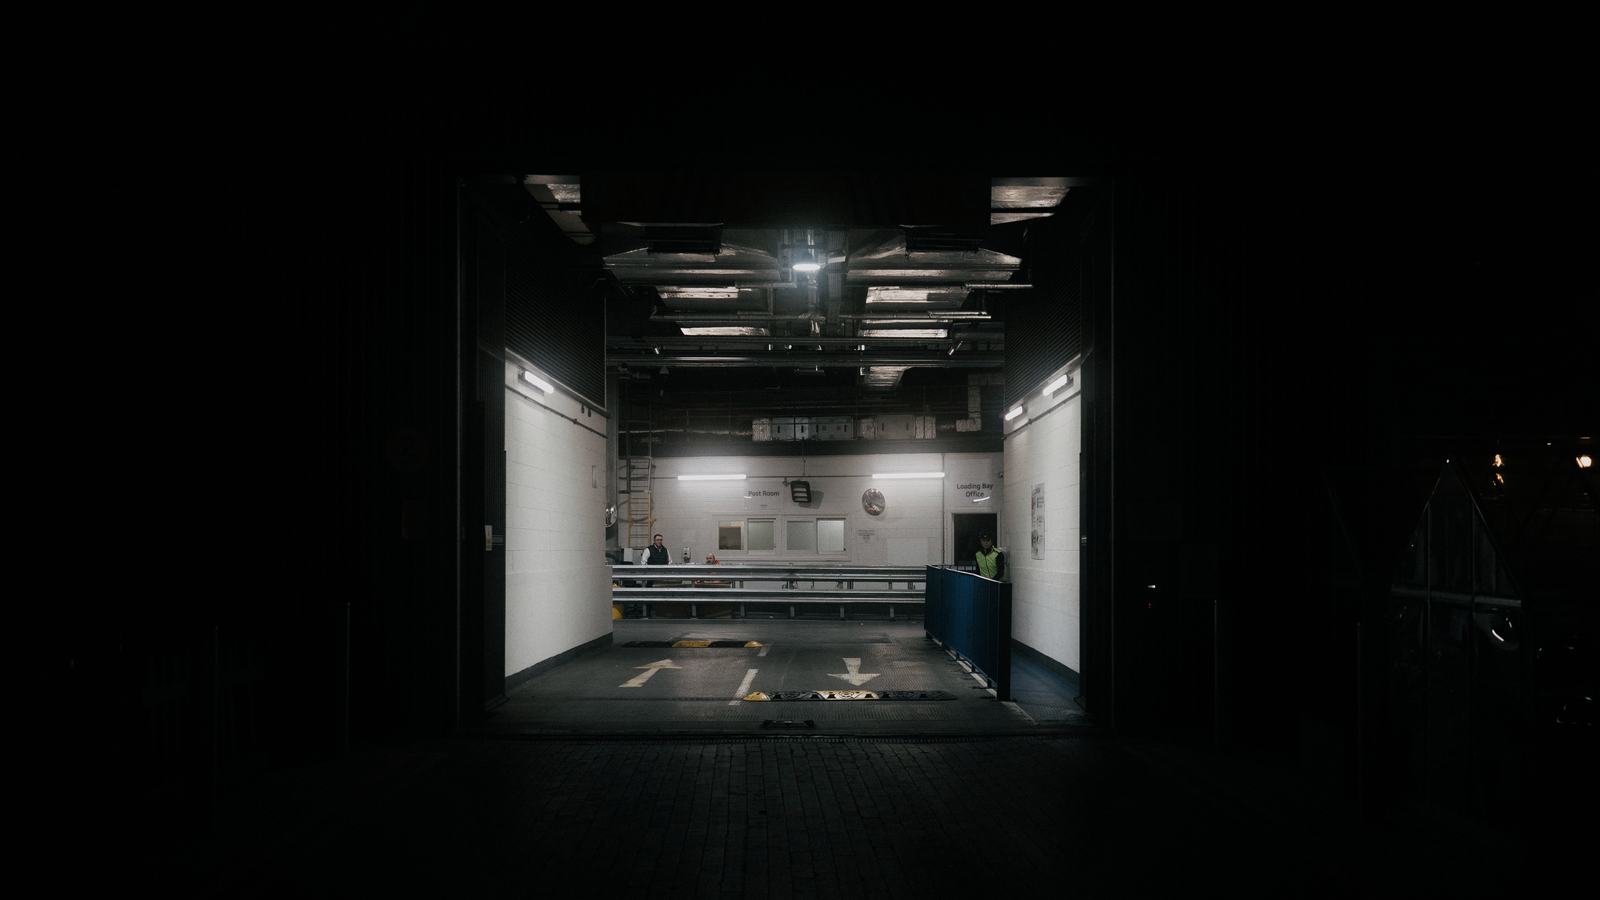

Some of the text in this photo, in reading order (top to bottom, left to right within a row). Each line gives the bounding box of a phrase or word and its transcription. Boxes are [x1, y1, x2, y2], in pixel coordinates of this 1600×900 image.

[956, 482, 994, 491] Loading Bay
[965, 490, 985, 498] Office
